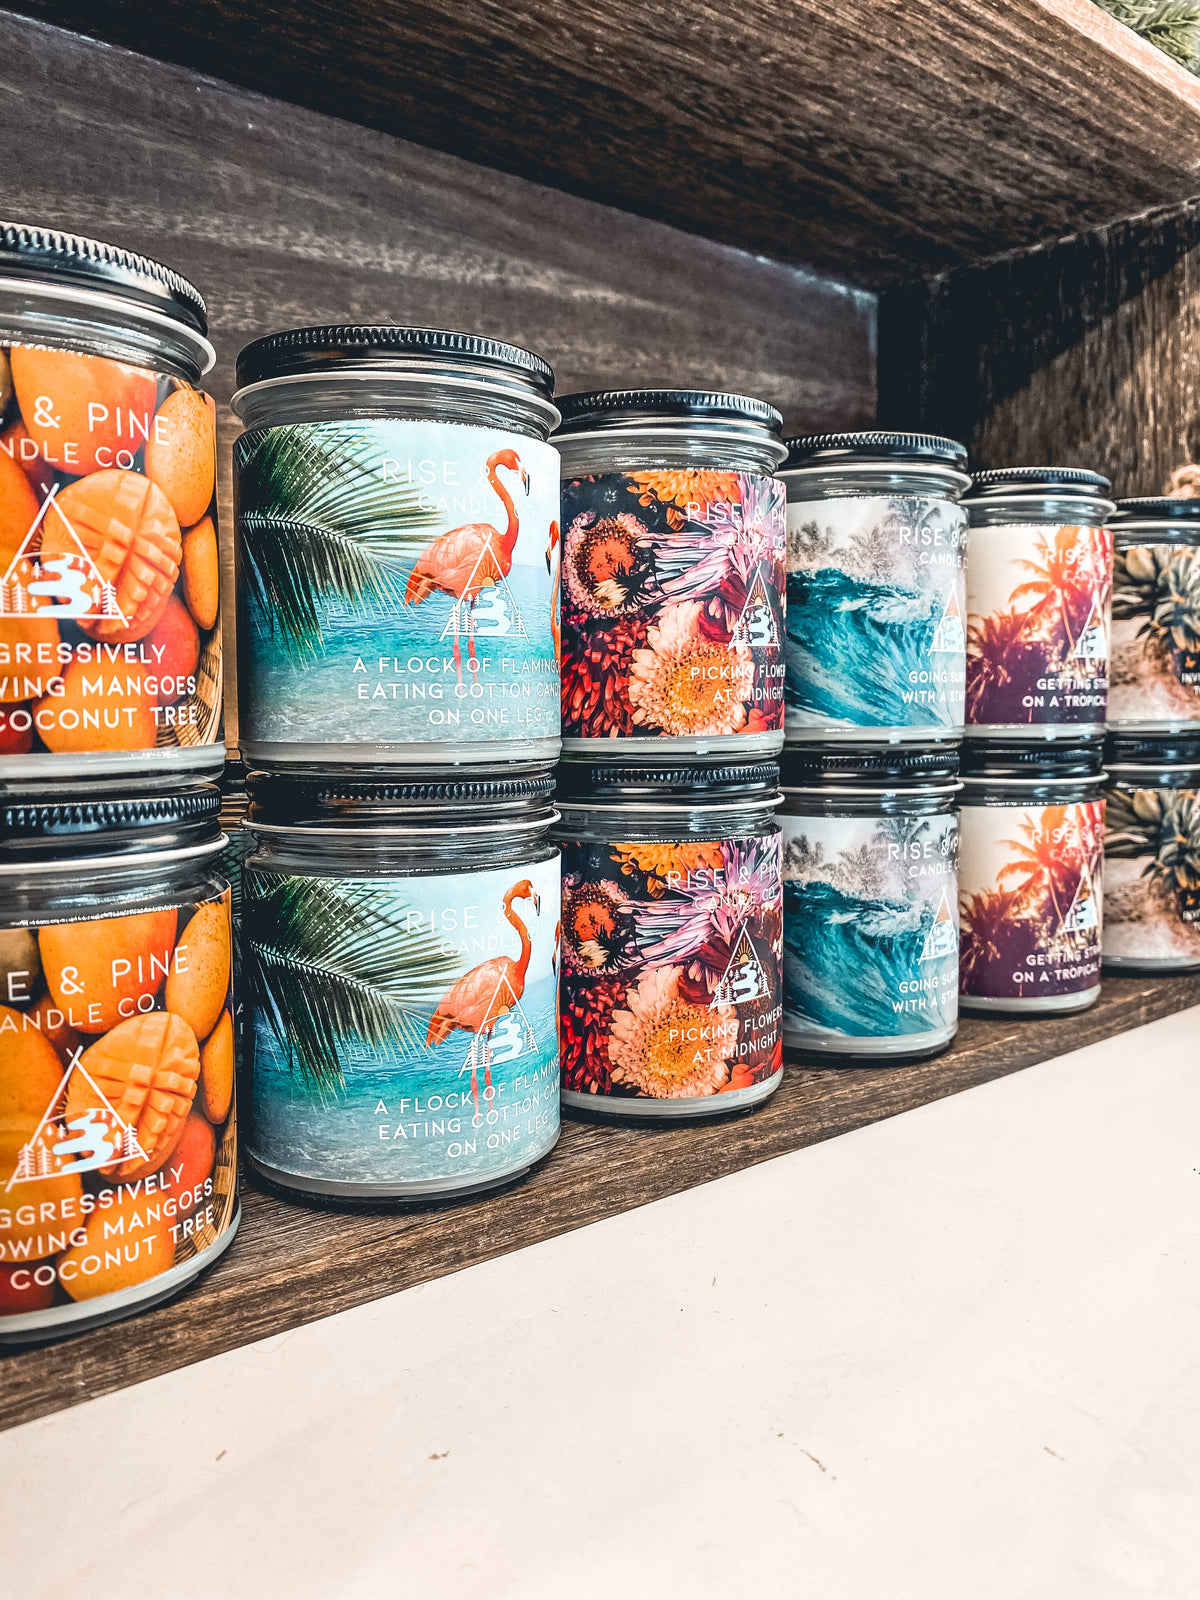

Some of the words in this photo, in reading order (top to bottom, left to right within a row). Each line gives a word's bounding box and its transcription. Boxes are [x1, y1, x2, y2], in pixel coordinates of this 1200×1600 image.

[88, 402, 171, 446] PINE
[95, 446, 142, 472] CO.
[382, 458, 459, 485] RISE
[417, 495, 508, 517] CANDLE
[687, 501, 743, 522] RISE
[899, 526, 944, 546] RISE
[920, 552, 962, 568] CANDLE
[352, 657, 368, 674] A
[379, 656, 456, 674] FLOCK
[466, 656, 492, 673] OF
[691, 663, 754, 681] PICKING
[82, 675, 197, 697] MANGOES
[908, 670, 948, 684] GOING
[1036, 678, 1091, 691] GETTING
[357, 683, 443, 700] EATING
[454, 682, 531, 699] COTTON
[712, 689, 732, 703] AT
[740, 686, 784, 701] MIDNIGHT
[902, 690, 936, 704] WITH
[939, 690, 947, 704] A
[1021, 695, 1044, 708] ON
[1049, 695, 1060, 707] A
[149, 705, 198, 726] TREE
[429, 709, 459, 725] ON
[470, 708, 509, 725] ONE
[517, 707, 542, 723] LEG
[888, 841, 933, 860] RISE
[668, 868, 726, 890] RISE
[909, 861, 952, 878] CANDLE
[406, 905, 479, 934] RISE
[440, 932, 520, 957] CANDLE
[1026, 949, 1082, 967] GETTING
[60, 965, 86, 996] &
[111, 945, 190, 988] PINE
[1012, 971, 1034, 984] ON
[1039, 970, 1050, 982] A
[899, 974, 938, 994] GOING
[118, 993, 161, 1018] CO.
[892, 997, 926, 1014] WITH
[930, 994, 938, 1009] A
[669, 1021, 738, 1043] PICKING
[692, 1047, 714, 1064] AT
[722, 1029, 777, 1061] MIDNIGHT
[374, 1098, 389, 1115] A
[400, 1089, 474, 1115] FLOCK
[483, 1082, 507, 1102] OF
[515, 1050, 560, 1093] FLAMING
[379, 1116, 461, 1141] EATING
[472, 1091, 540, 1129] COTTON
[543, 1072, 560, 1100] CAN
[446, 1137, 477, 1159] ON
[486, 1125, 521, 1149] ONE
[528, 1109, 549, 1135] LEG
[104, 1177, 214, 1236] MANGOES
[10, 1234, 157, 1291] COCONUT
[168, 1205, 215, 1245] TREE
